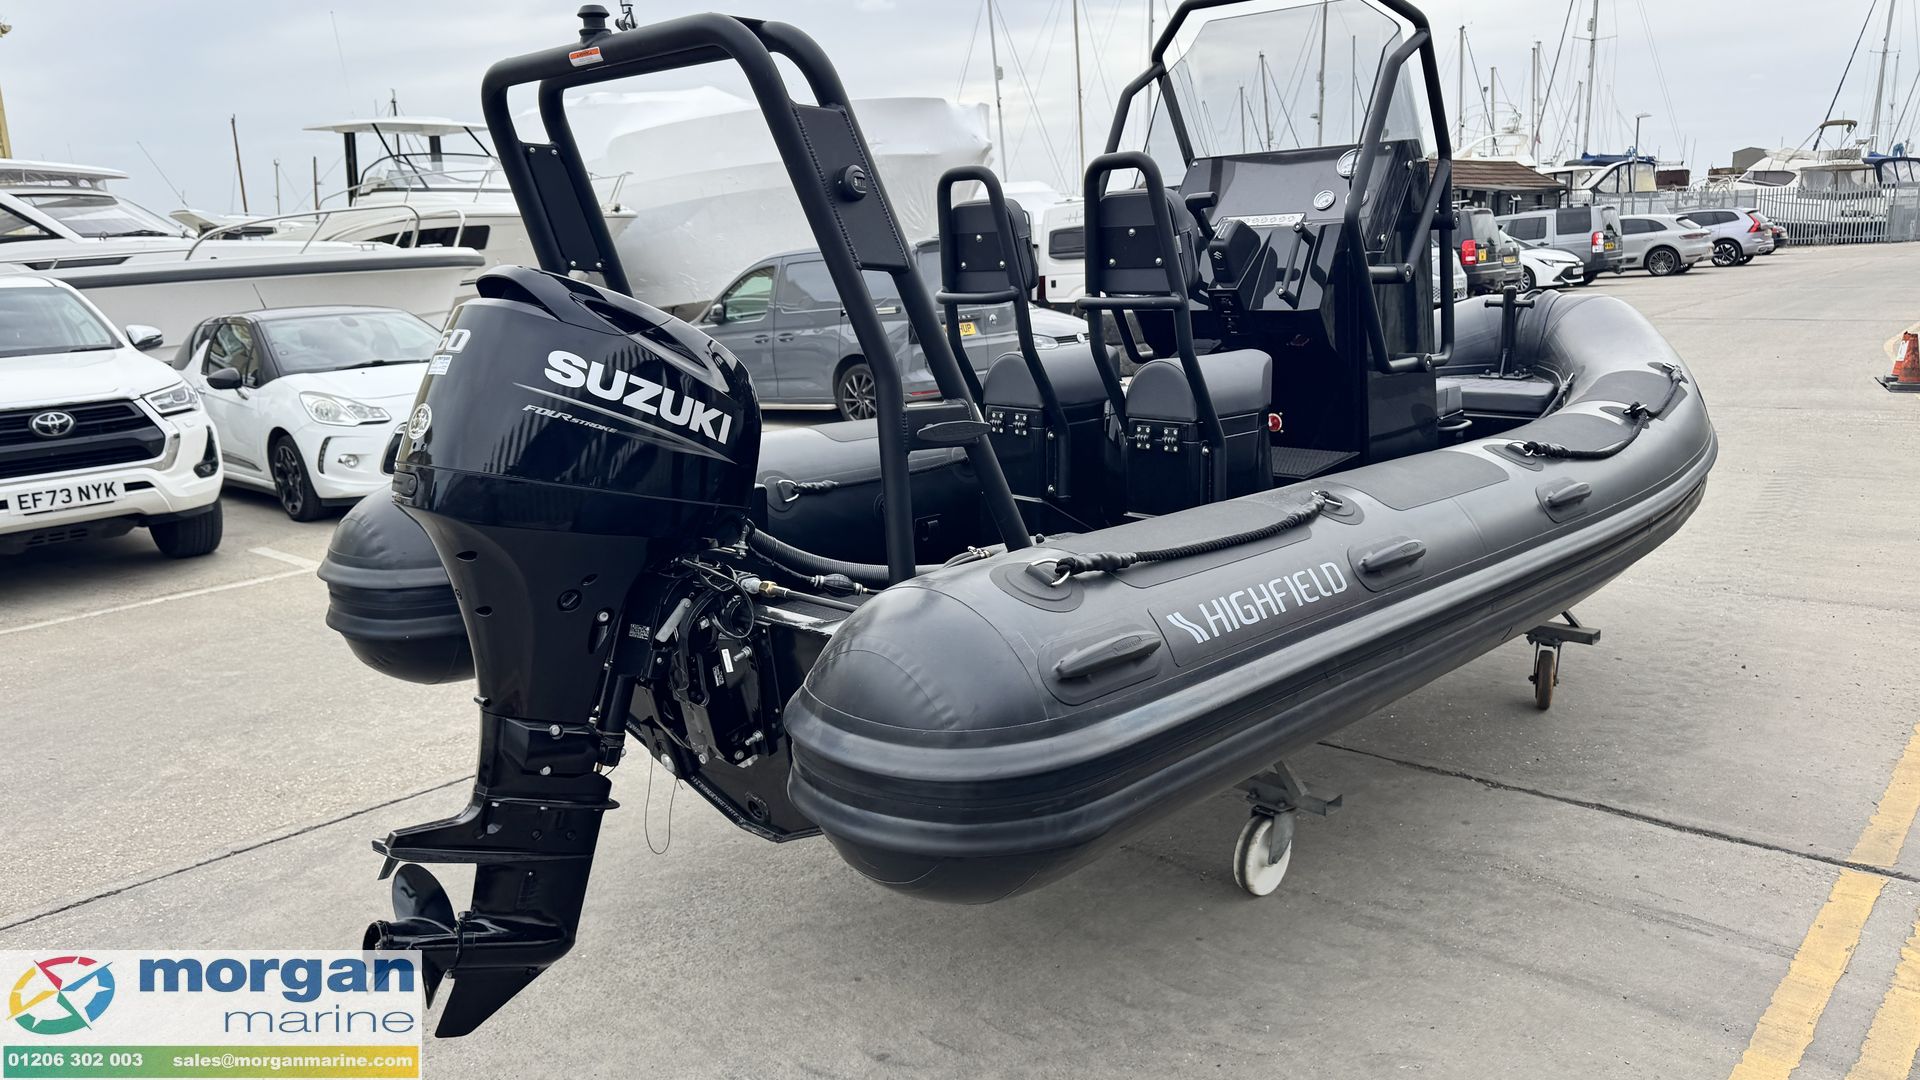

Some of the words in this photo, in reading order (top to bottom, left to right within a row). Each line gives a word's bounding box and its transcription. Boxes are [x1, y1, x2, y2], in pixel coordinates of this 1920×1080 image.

[544, 350, 732, 445] SUZUKI
[17, 488, 73, 510] EF73
[77, 482, 117, 502] NYK
[1198, 561, 1348, 638] HIGHFIELD
